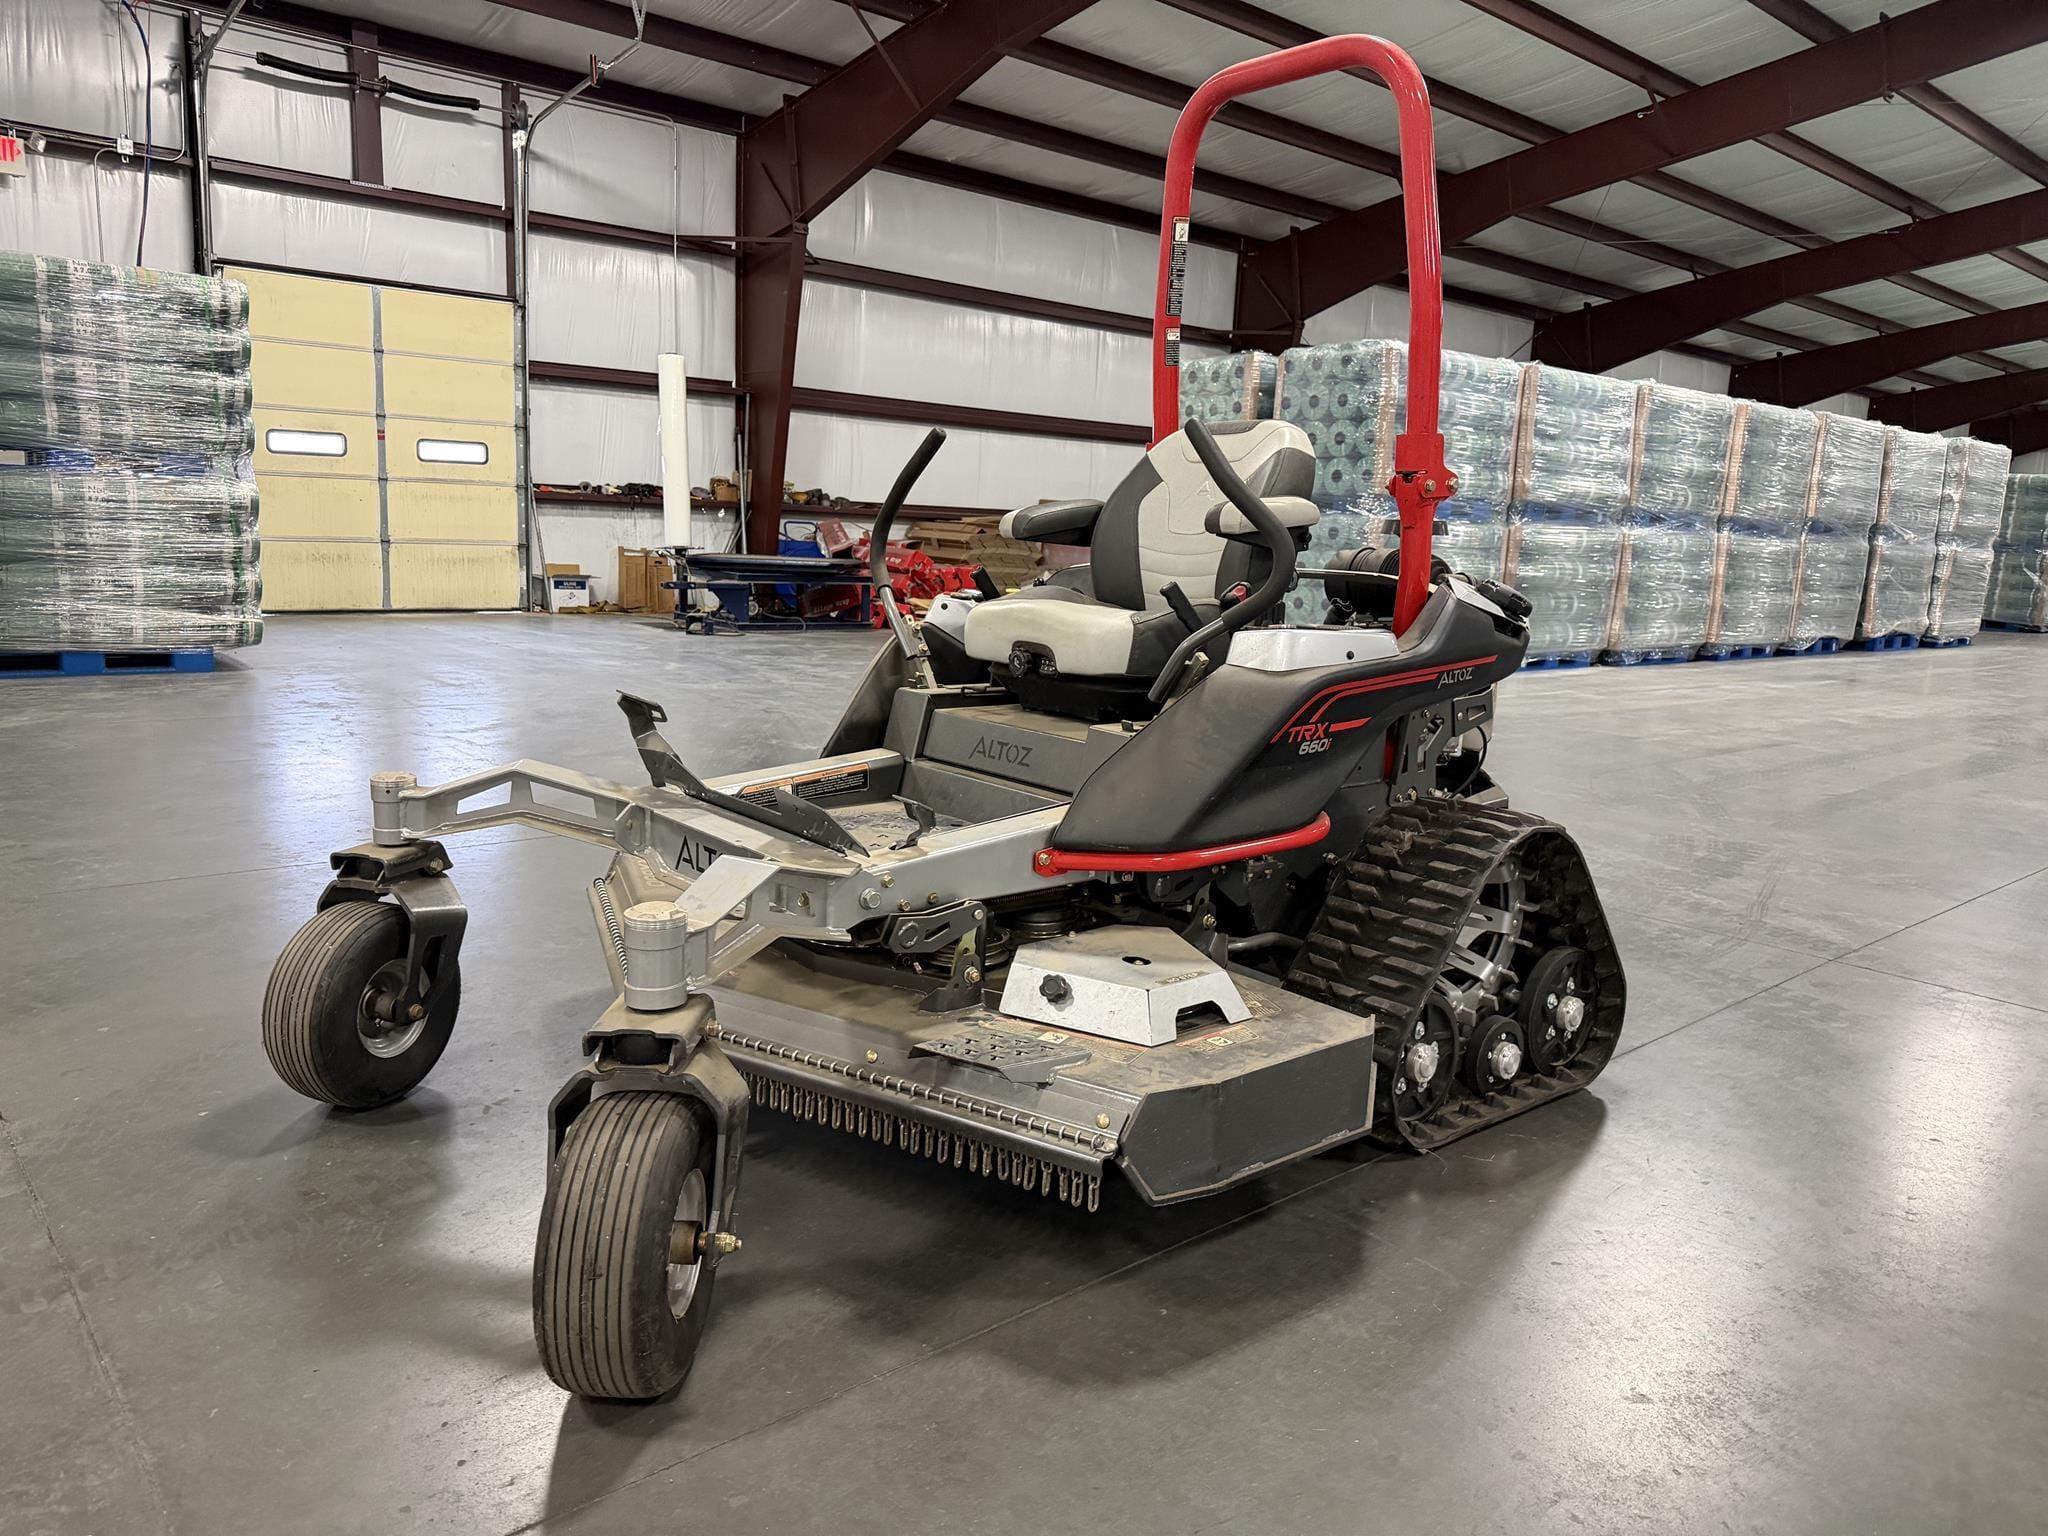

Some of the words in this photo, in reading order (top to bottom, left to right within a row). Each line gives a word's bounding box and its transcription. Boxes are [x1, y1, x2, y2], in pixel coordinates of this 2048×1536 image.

[0, 138, 16, 162] IT
[1437, 667, 1473, 689] ALTOZ
[1288, 722, 1329, 743] TRX
[968, 736, 1033, 767] ALTOZ
[1299, 738, 1332, 755] 660i
[675, 835, 726, 874] ALT
